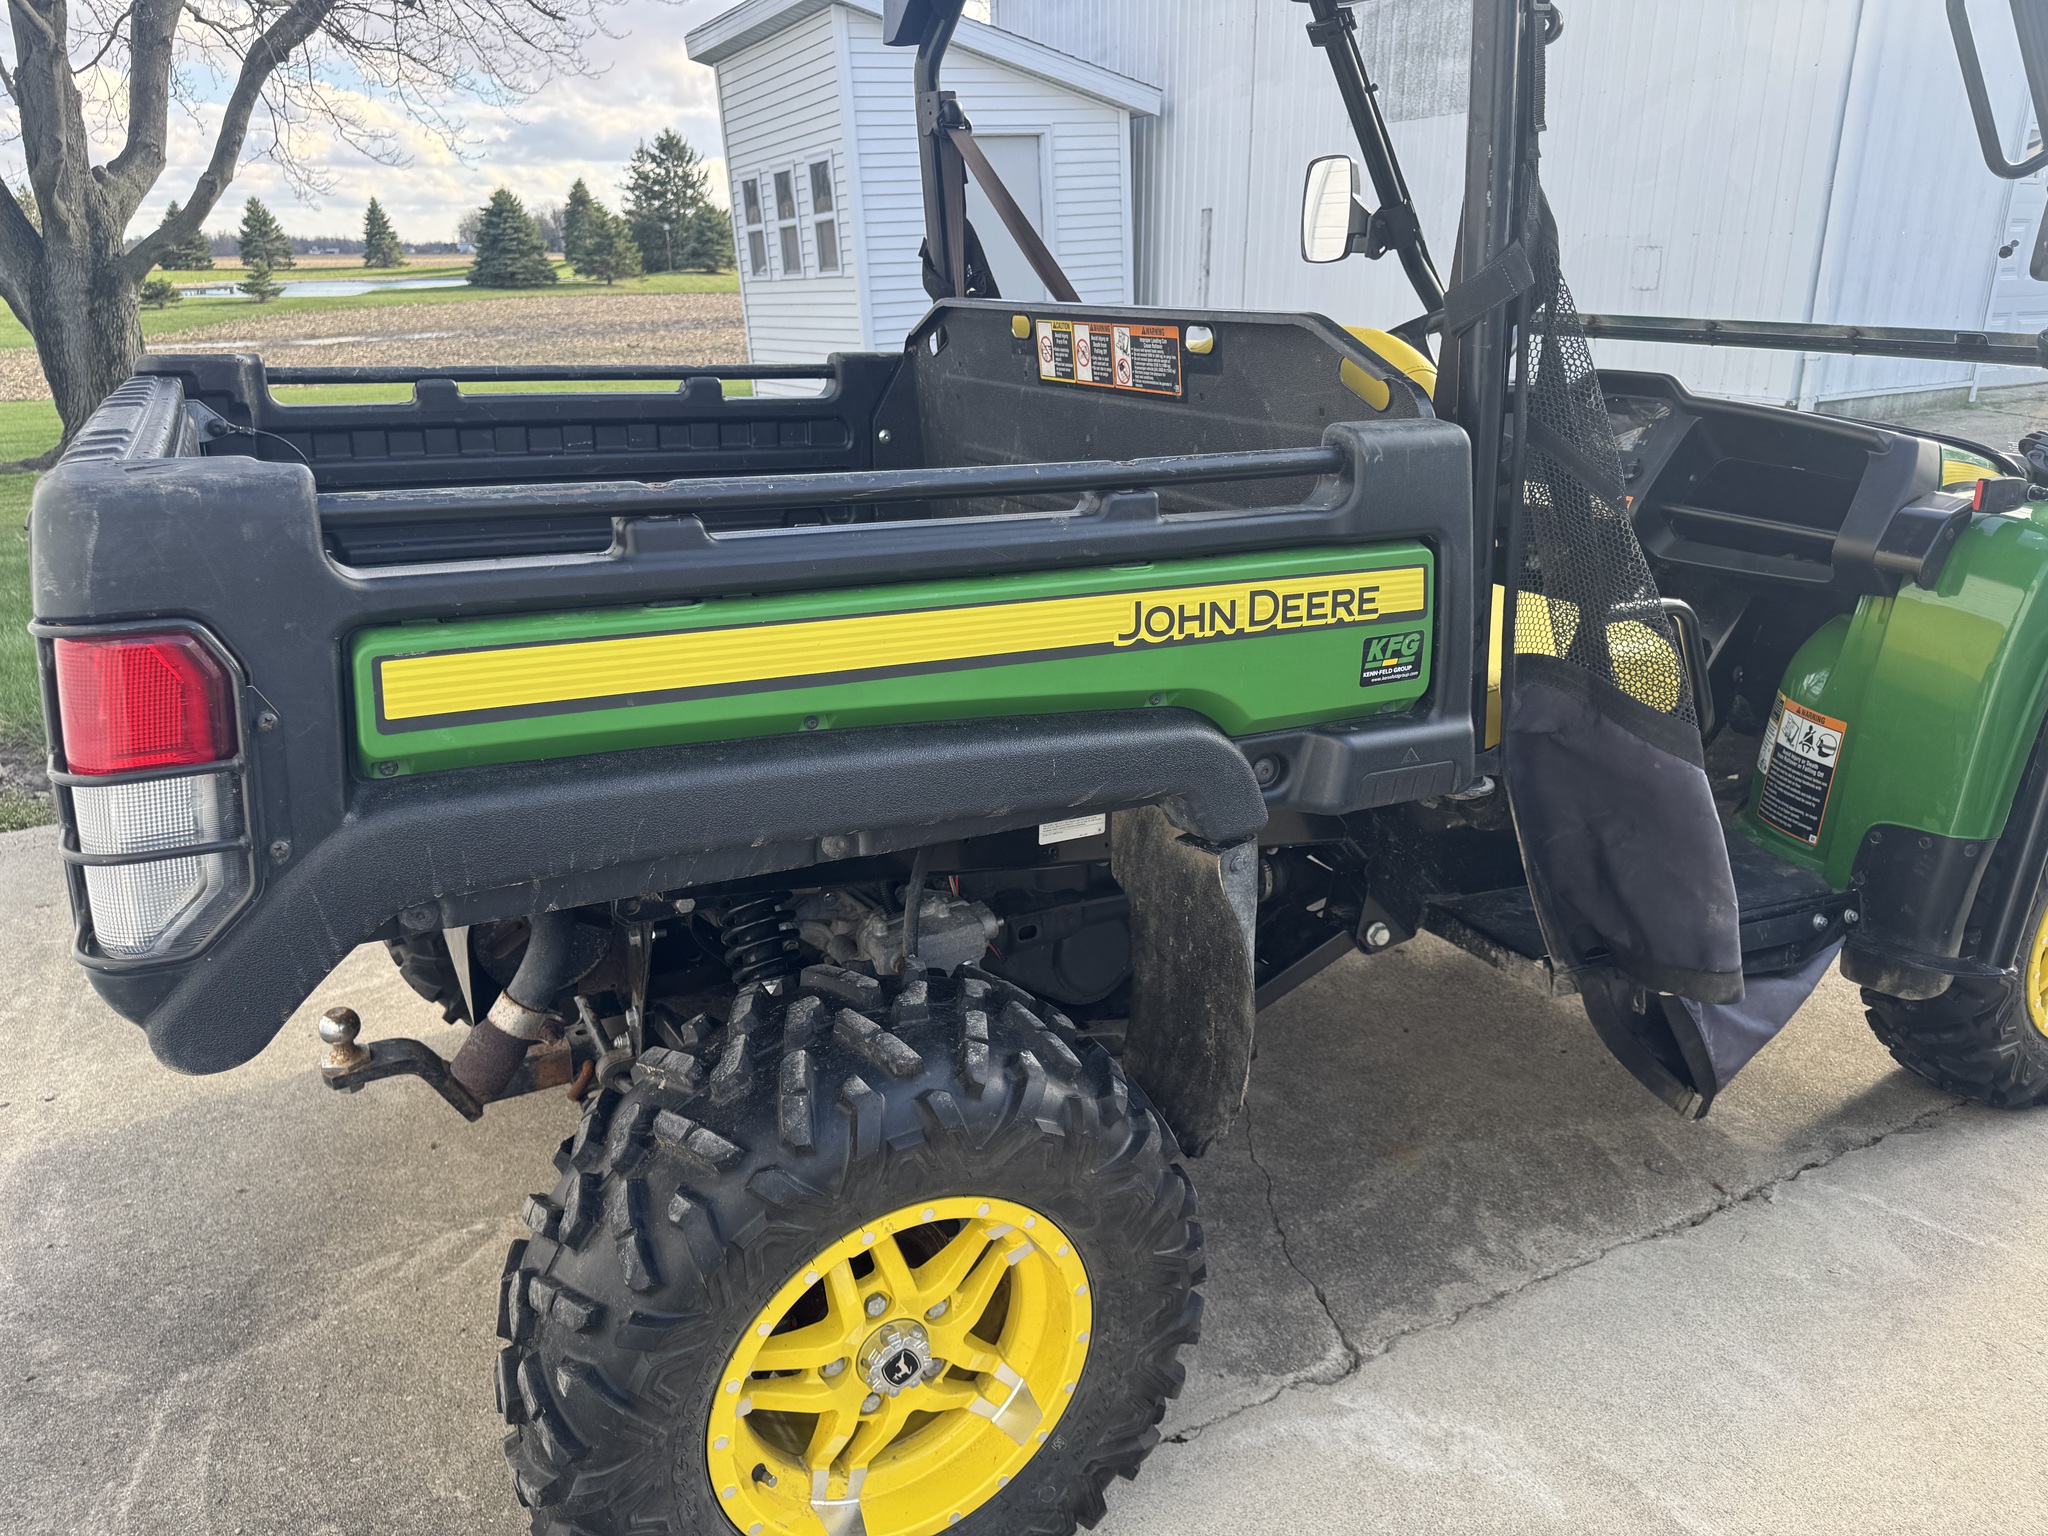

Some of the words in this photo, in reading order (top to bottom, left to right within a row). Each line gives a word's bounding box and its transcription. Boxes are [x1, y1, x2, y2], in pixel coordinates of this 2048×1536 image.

[1093, 324, 1110, 332] WARNING
[1145, 327, 1165, 336] WARNING
[1117, 600, 1237, 642] JOHN
[1248, 585, 1381, 628] DEERE
[1366, 633, 1421, 662] KFG
[1363, 667, 1393, 678] KENN-FELD
[1393, 665, 1413, 674] GROUP
[1371, 671, 1418, 682] www.kennfeldgroup.com
[1801, 708, 1826, 725] WARNING
